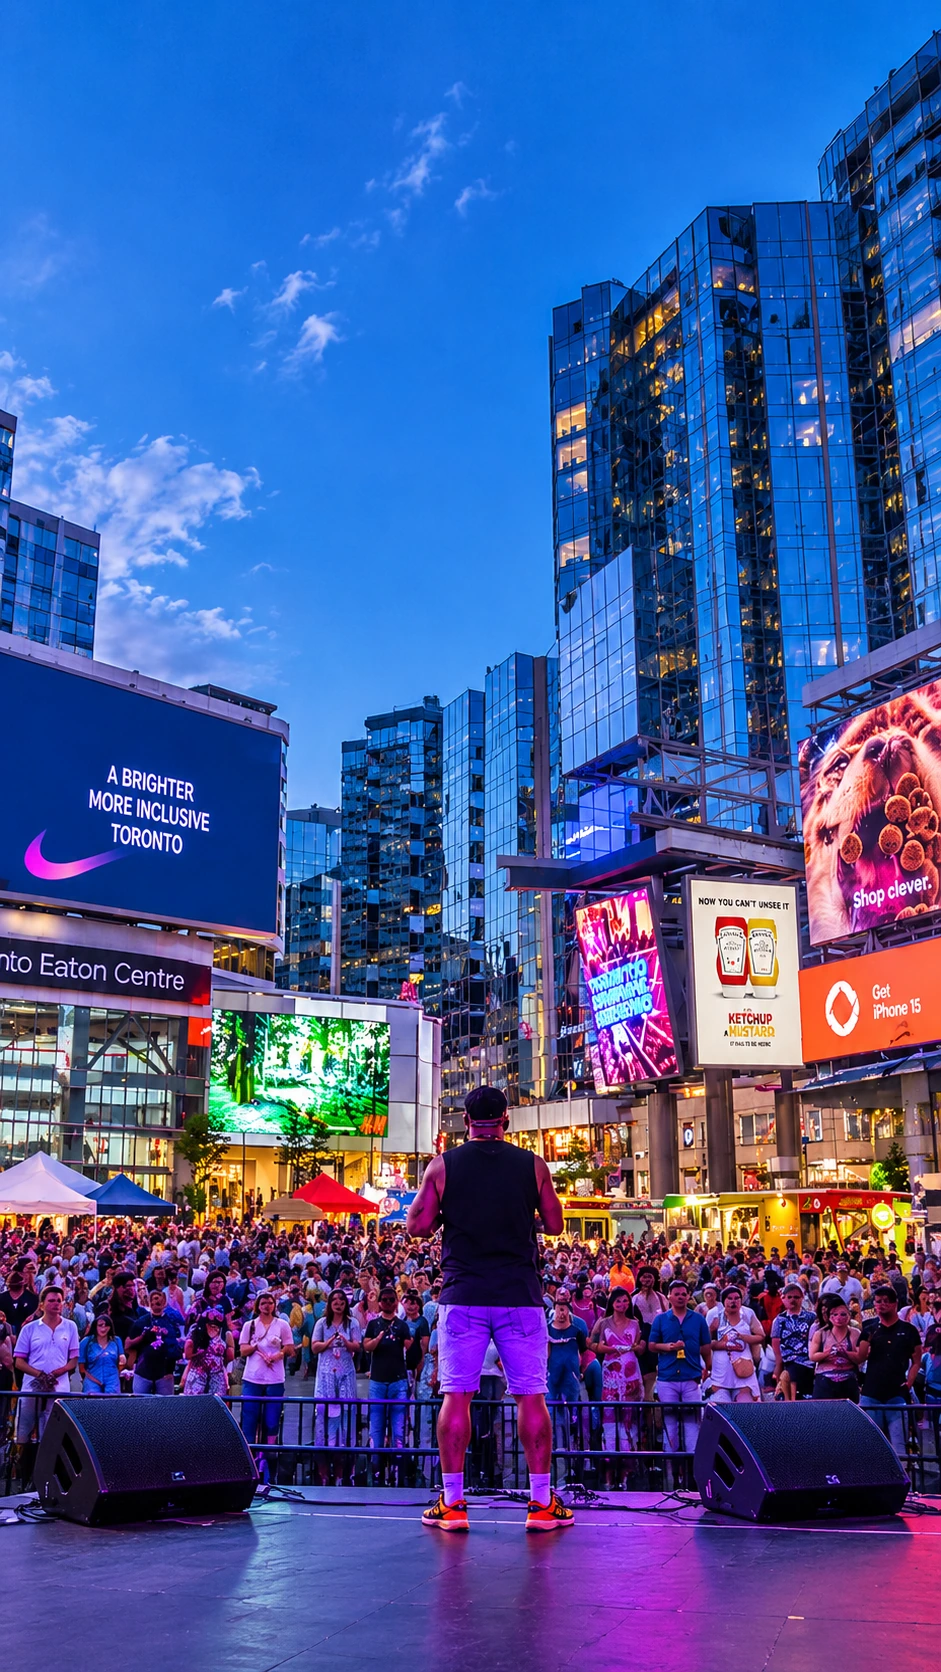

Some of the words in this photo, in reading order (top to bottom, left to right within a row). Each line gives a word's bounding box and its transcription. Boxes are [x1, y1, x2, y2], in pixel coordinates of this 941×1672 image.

[107, 765, 118, 785] A
[122, 767, 194, 802] BRIGHTER
[89, 789, 132, 816] MORE
[136, 798, 210, 832] INCLUSIVE
[111, 823, 183, 854] TORONTO
[698, 897, 717, 906] NOW
[718, 898, 734, 907] YOU
[735, 899, 757, 908] CAN'T
[758, 901, 781, 910] UNSEE
[782, 902, 790, 910] IT
[853, 883, 885, 909] Shop
[887, 875, 933, 900] clever.
[40, 953, 107, 981] Eaton
[114, 963, 185, 990] Centre
[872, 983, 891, 1000] Get
[728, 1012, 773, 1025] KETCHUP
[872, 1001, 909, 1020] iPhone
[909, 997, 922, 1014] 15
[729, 1025, 775, 1037] MUSTARD
